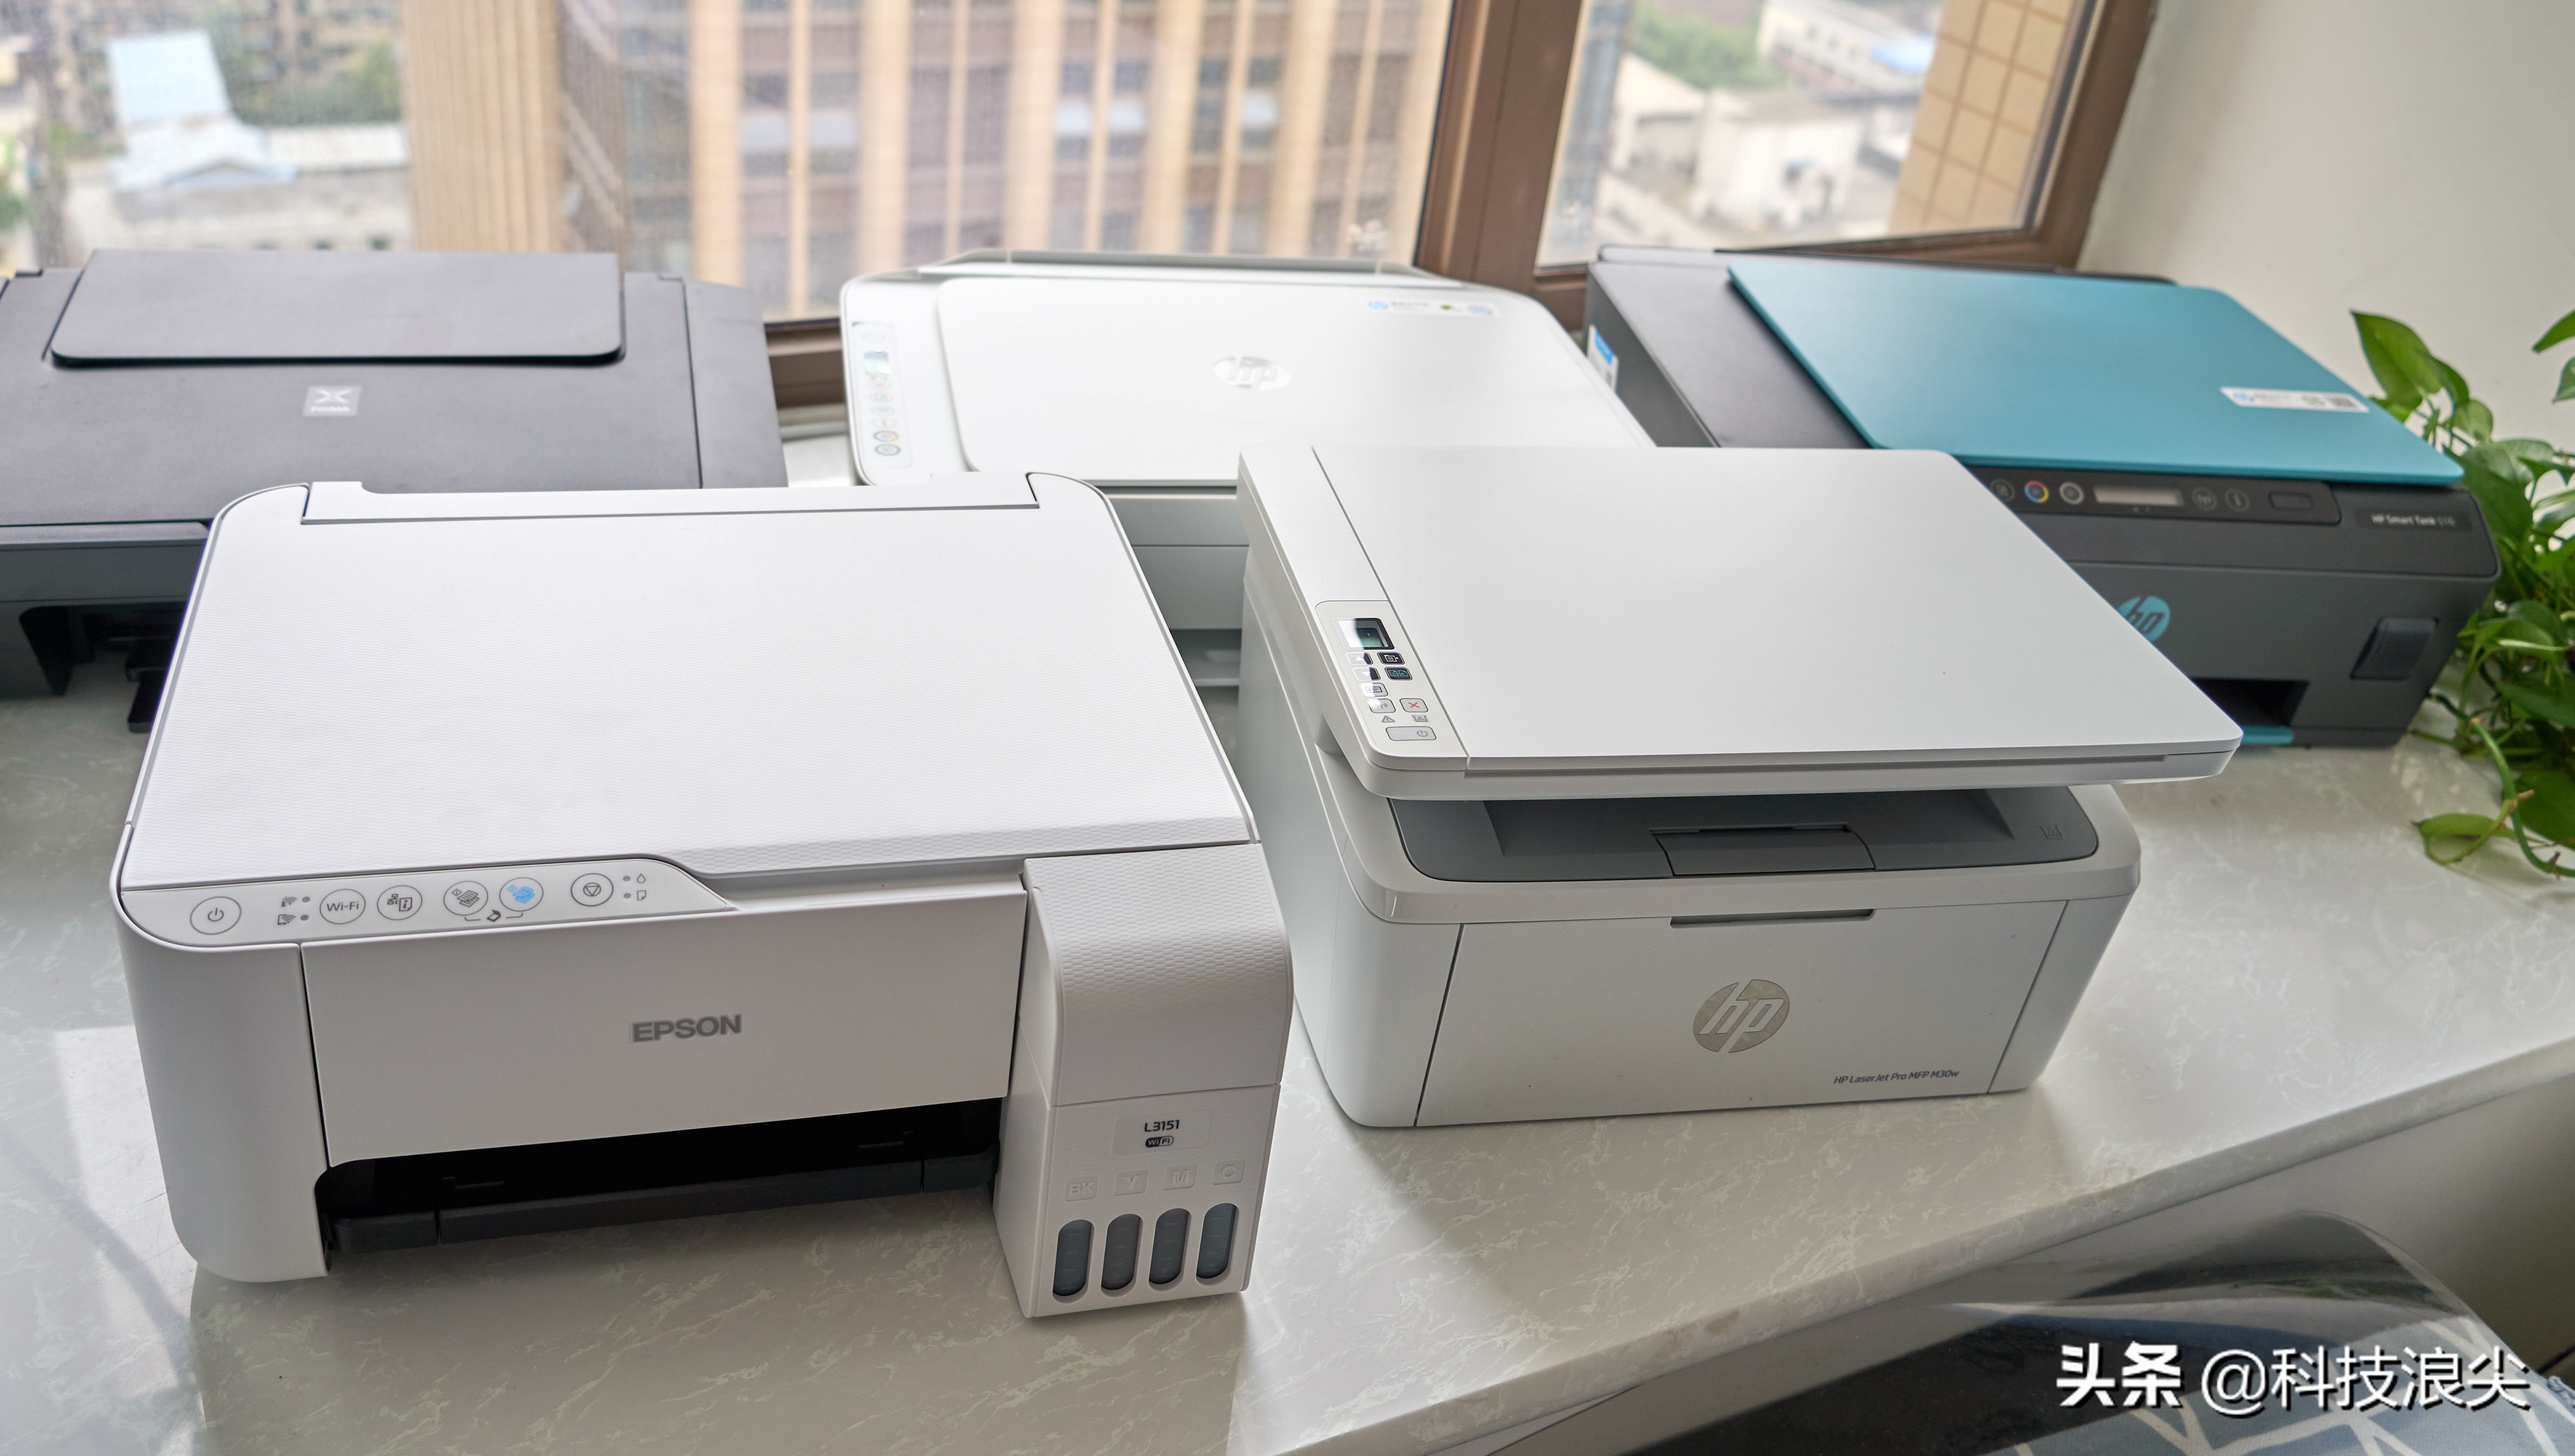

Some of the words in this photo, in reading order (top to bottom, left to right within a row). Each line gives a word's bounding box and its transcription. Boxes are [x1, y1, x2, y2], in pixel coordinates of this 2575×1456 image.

[1227, 356, 1281, 390] hp
[2386, 514, 2413, 525] Smart
[2414, 515, 2436, 526] Tank
[327, 900, 359, 912] Wi-Fi
[1697, 980, 1786, 1052] hp
[633, 1014, 741, 1042] EPSON
[1849, 1074, 1889, 1083] LaserJet
[1908, 1071, 1930, 1079] MFP
[1930, 1070, 1959, 1078] M30w
[1144, 1119, 1180, 1132] L3151
[1170, 1169, 1189, 1184] M
[1221, 1164, 1236, 1177] C
[1069, 1181, 1095, 1194] BK
[1125, 1175, 1139, 1190] Y
